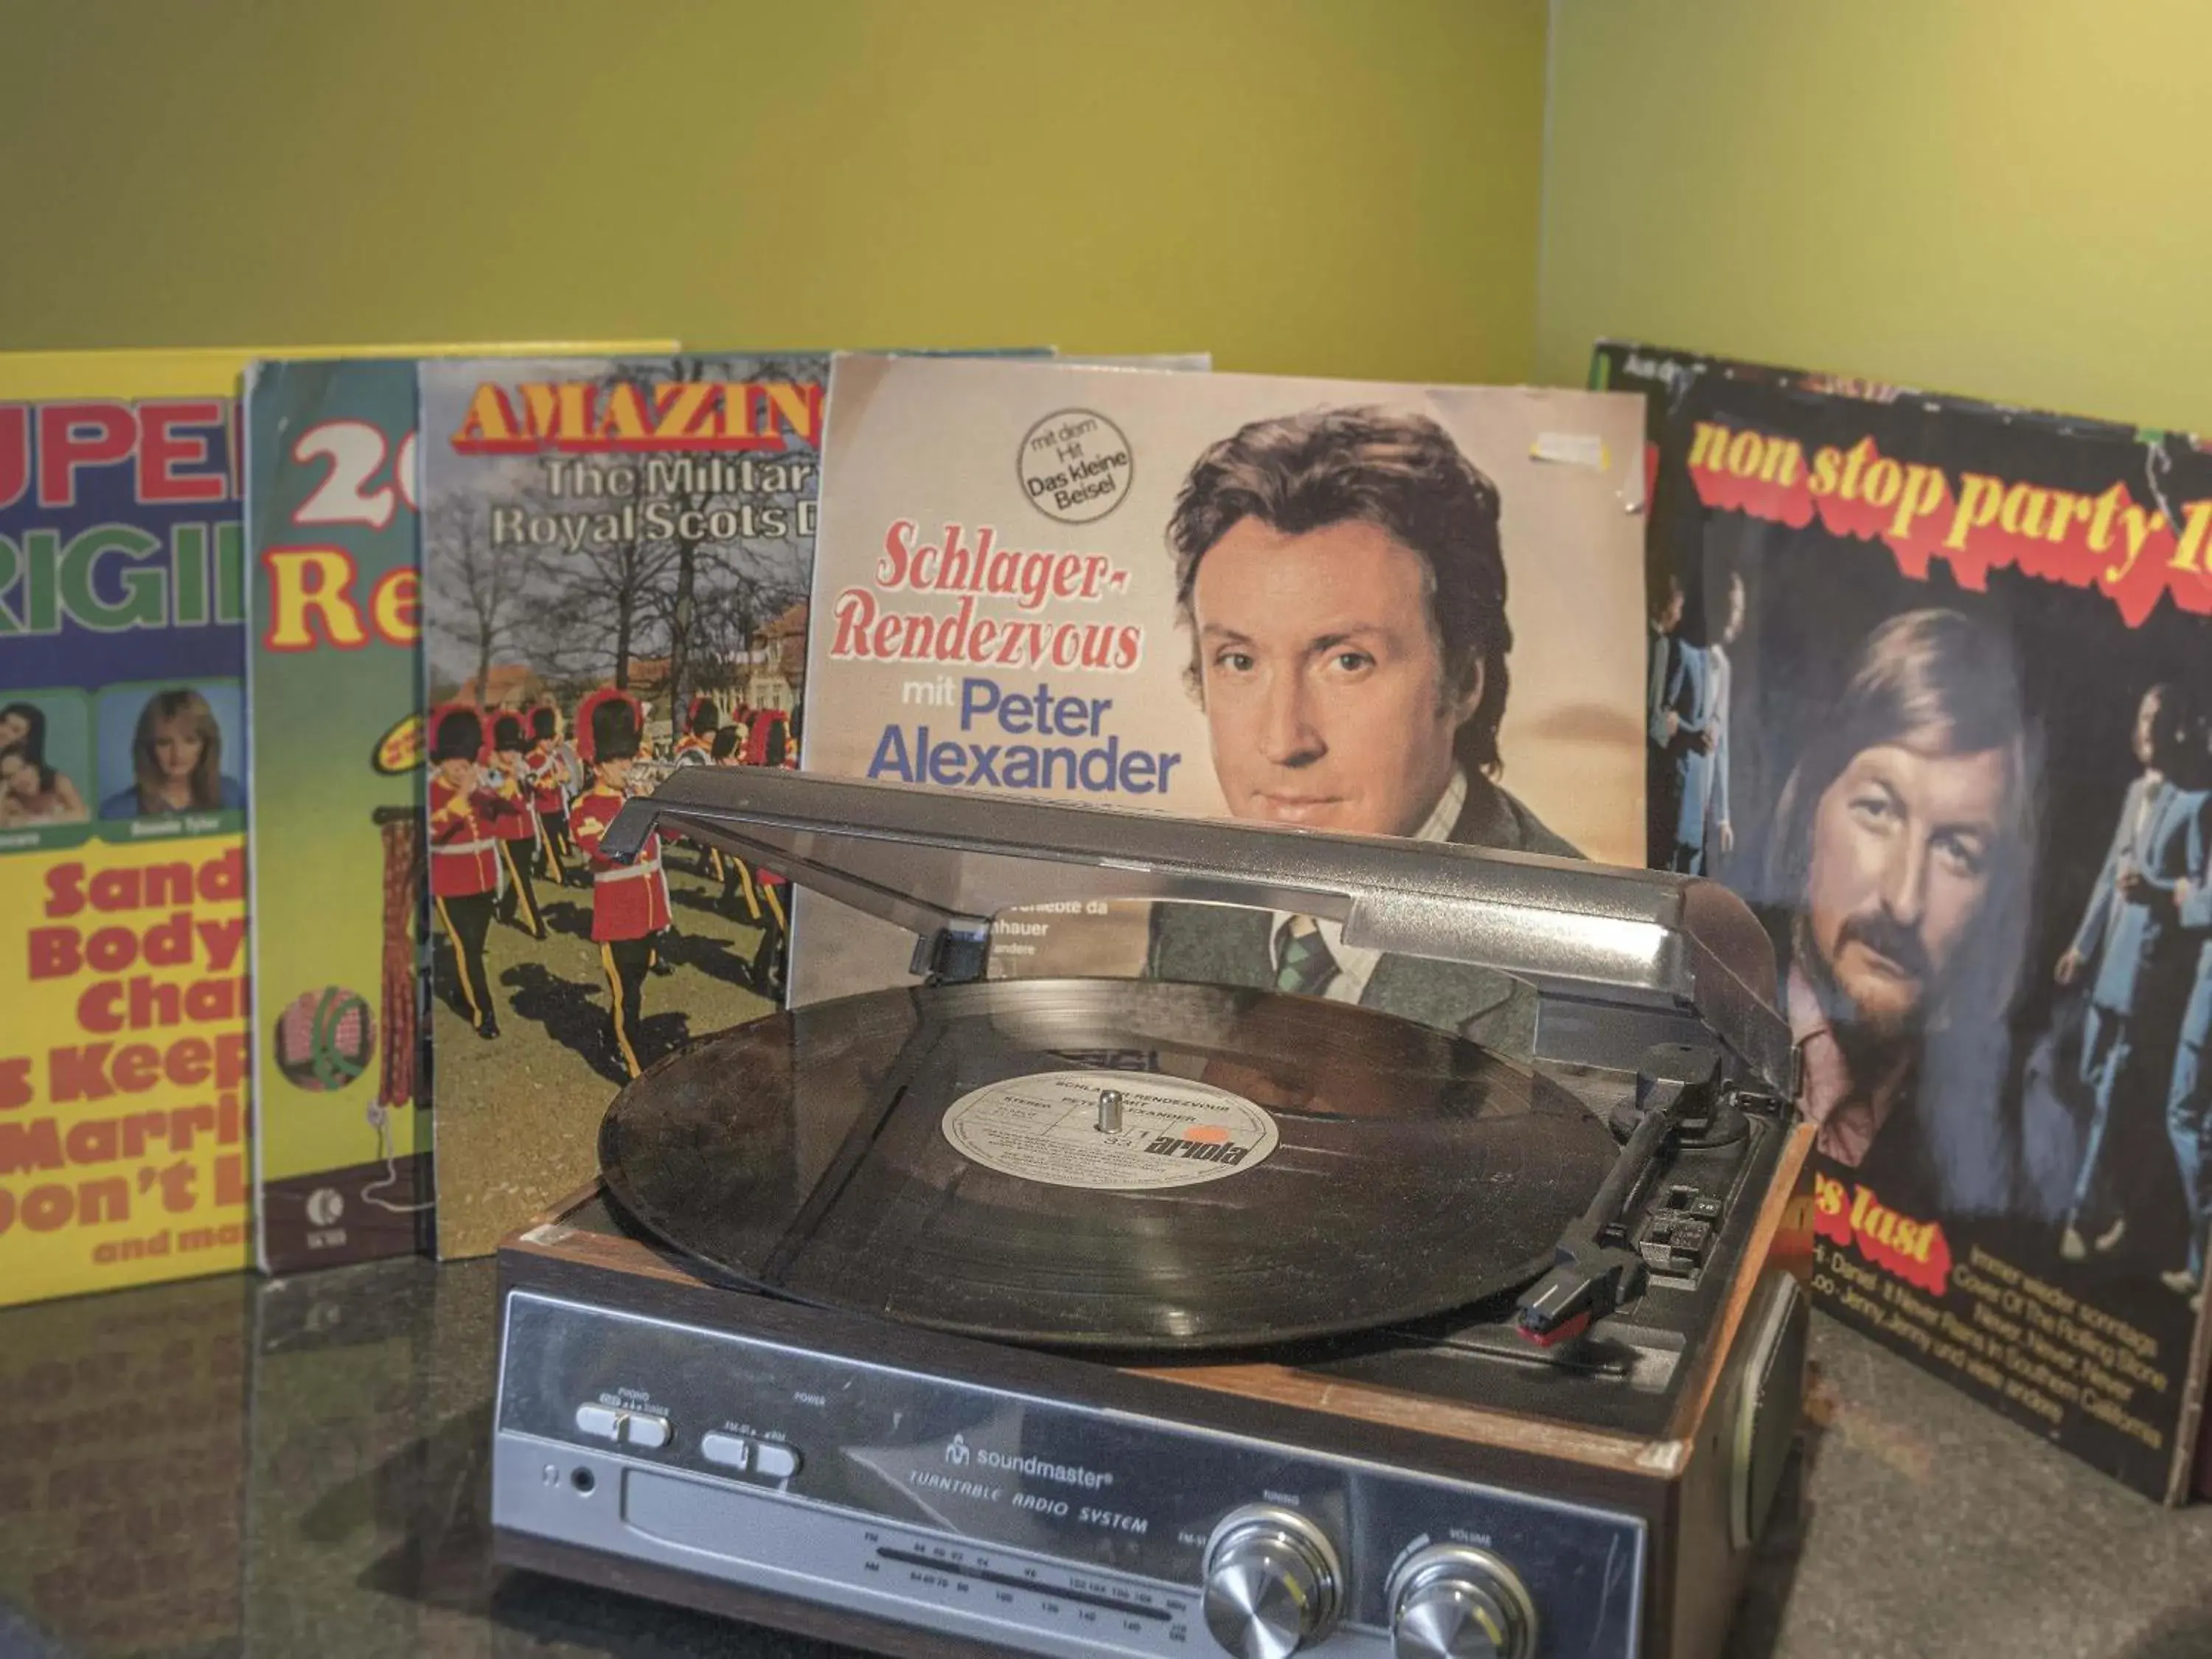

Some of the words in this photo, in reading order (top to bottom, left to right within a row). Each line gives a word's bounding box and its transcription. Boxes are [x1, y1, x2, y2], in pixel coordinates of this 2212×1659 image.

[451, 380, 823, 456] AMAZIN
[1032, 431, 1057, 452] mit
[1059, 420, 1098, 442] dem
[546, 459, 636, 497] The
[1027, 473, 1068, 496] Das
[1068, 451, 1127, 481] kleine
[1056, 442, 1084, 464] Hit
[1054, 473, 1116, 510] Beisel
[1688, 420, 1806, 488] non
[1809, 435, 1947, 538] stop
[1942, 472, 2165, 583] party
[491, 502, 635, 552] Royal
[644, 500, 787, 542] Scots
[875, 518, 1130, 610] Schlager-
[830, 588, 1144, 672] Rendezvous
[901, 674, 956, 707] mit
[960, 677, 1113, 737] Peter
[866, 723, 1182, 795] Alexander
[77, 975, 249, 1036] Cha
[0, 1158, 199, 1238] on't
[1849, 1183, 1940, 1264] last
[93, 1228, 171, 1265] and
[909, 1471, 1003, 1502] TURNTABLE
[1012, 1492, 1068, 1517] RADIO
[1079, 1506, 1149, 1534] SYSTEM
